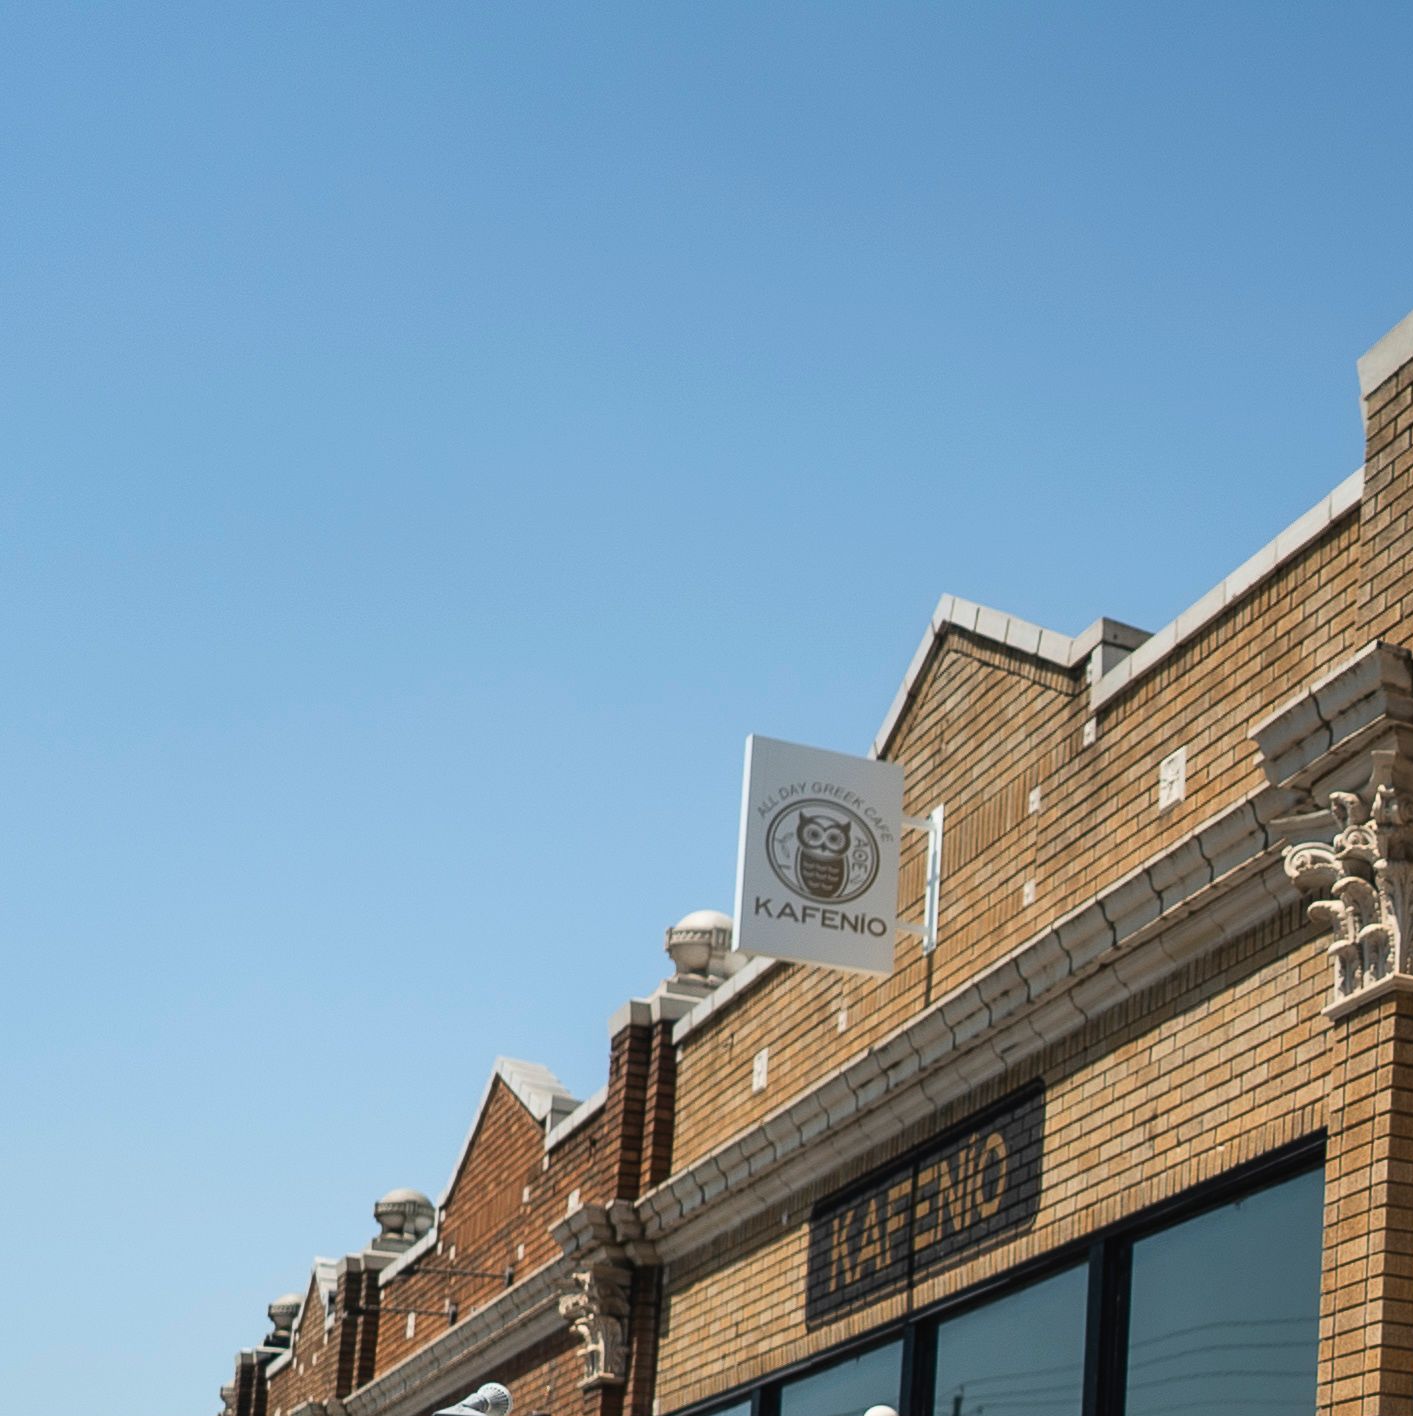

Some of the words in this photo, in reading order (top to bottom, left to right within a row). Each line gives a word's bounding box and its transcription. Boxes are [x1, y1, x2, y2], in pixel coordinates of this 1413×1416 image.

[757, 795, 780, 820] ALL
[777, 782, 806, 801] DAY
[810, 781, 864, 809] GREEK
[863, 806, 895, 844] CAFE
